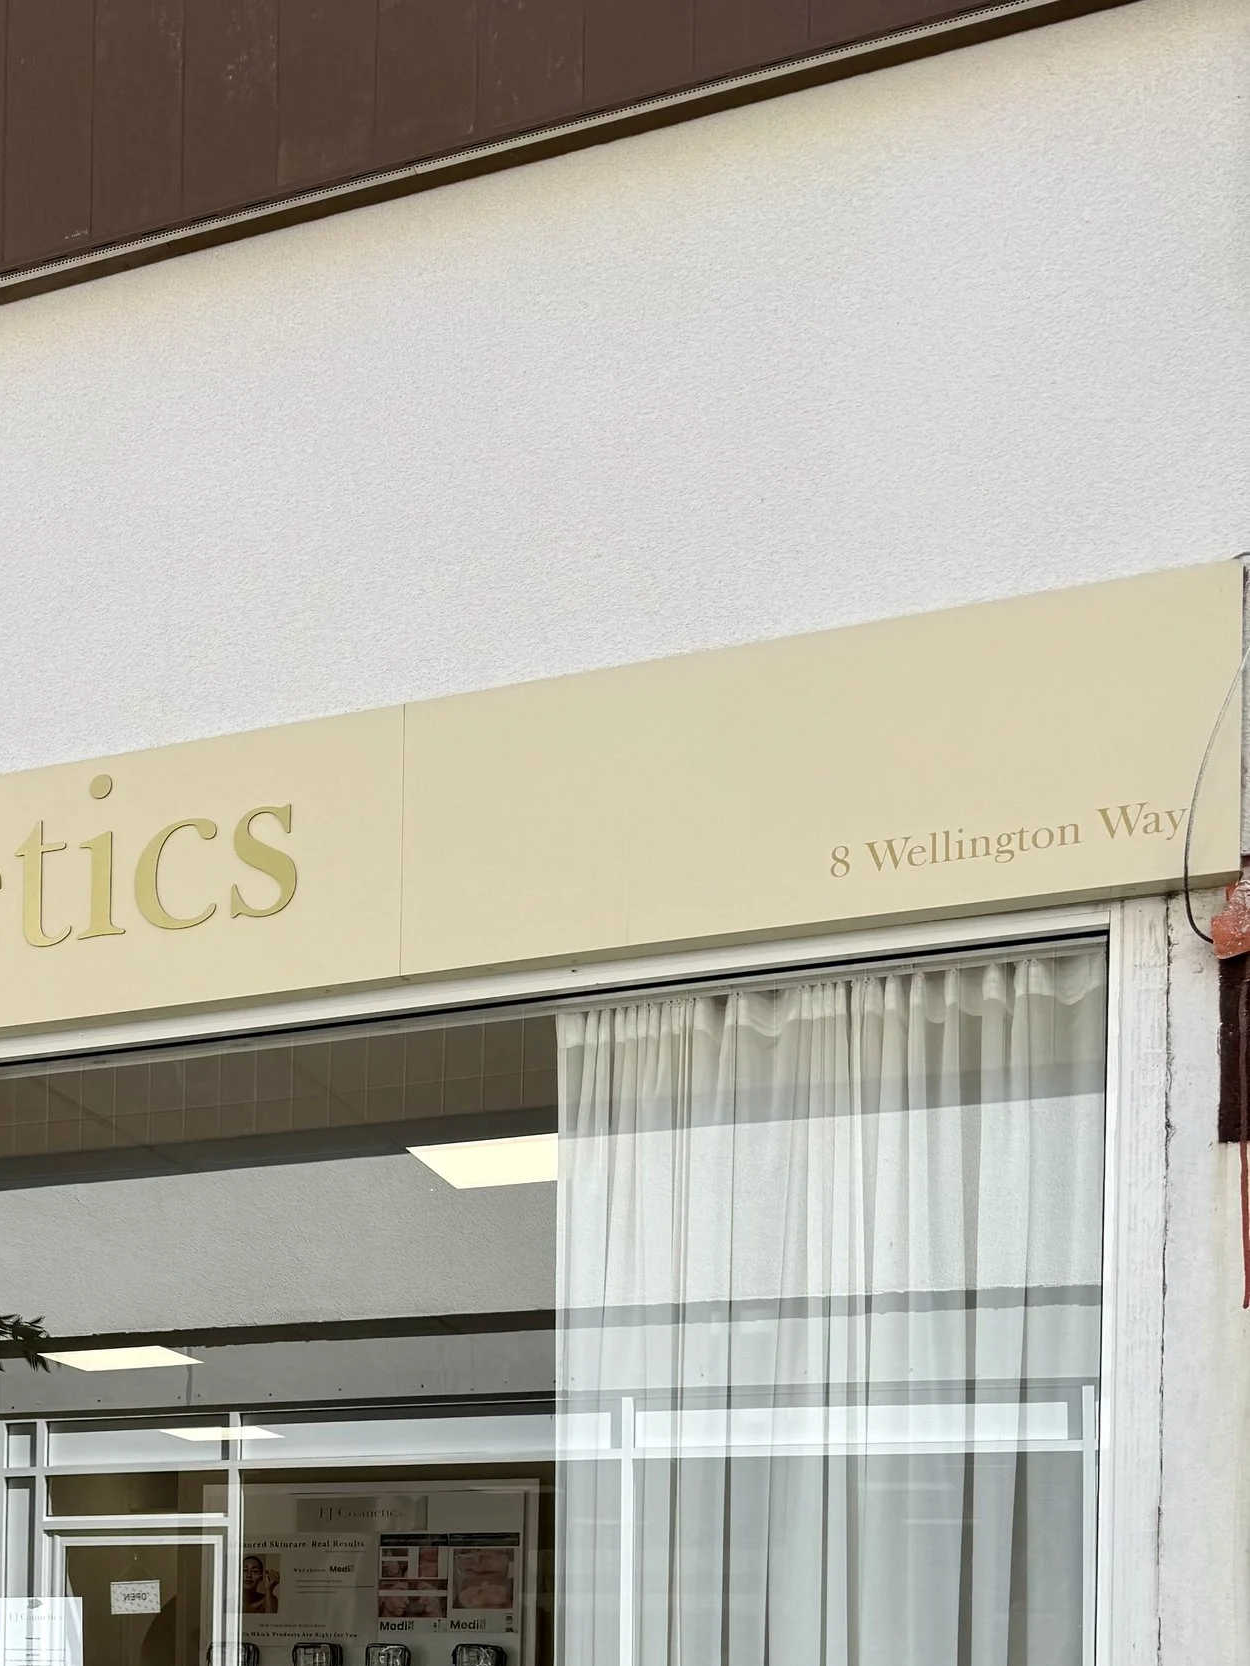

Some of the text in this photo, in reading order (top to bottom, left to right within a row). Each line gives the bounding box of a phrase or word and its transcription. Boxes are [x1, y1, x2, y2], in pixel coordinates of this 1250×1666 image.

[830, 802, 1187, 878] 8 Wellington Way
